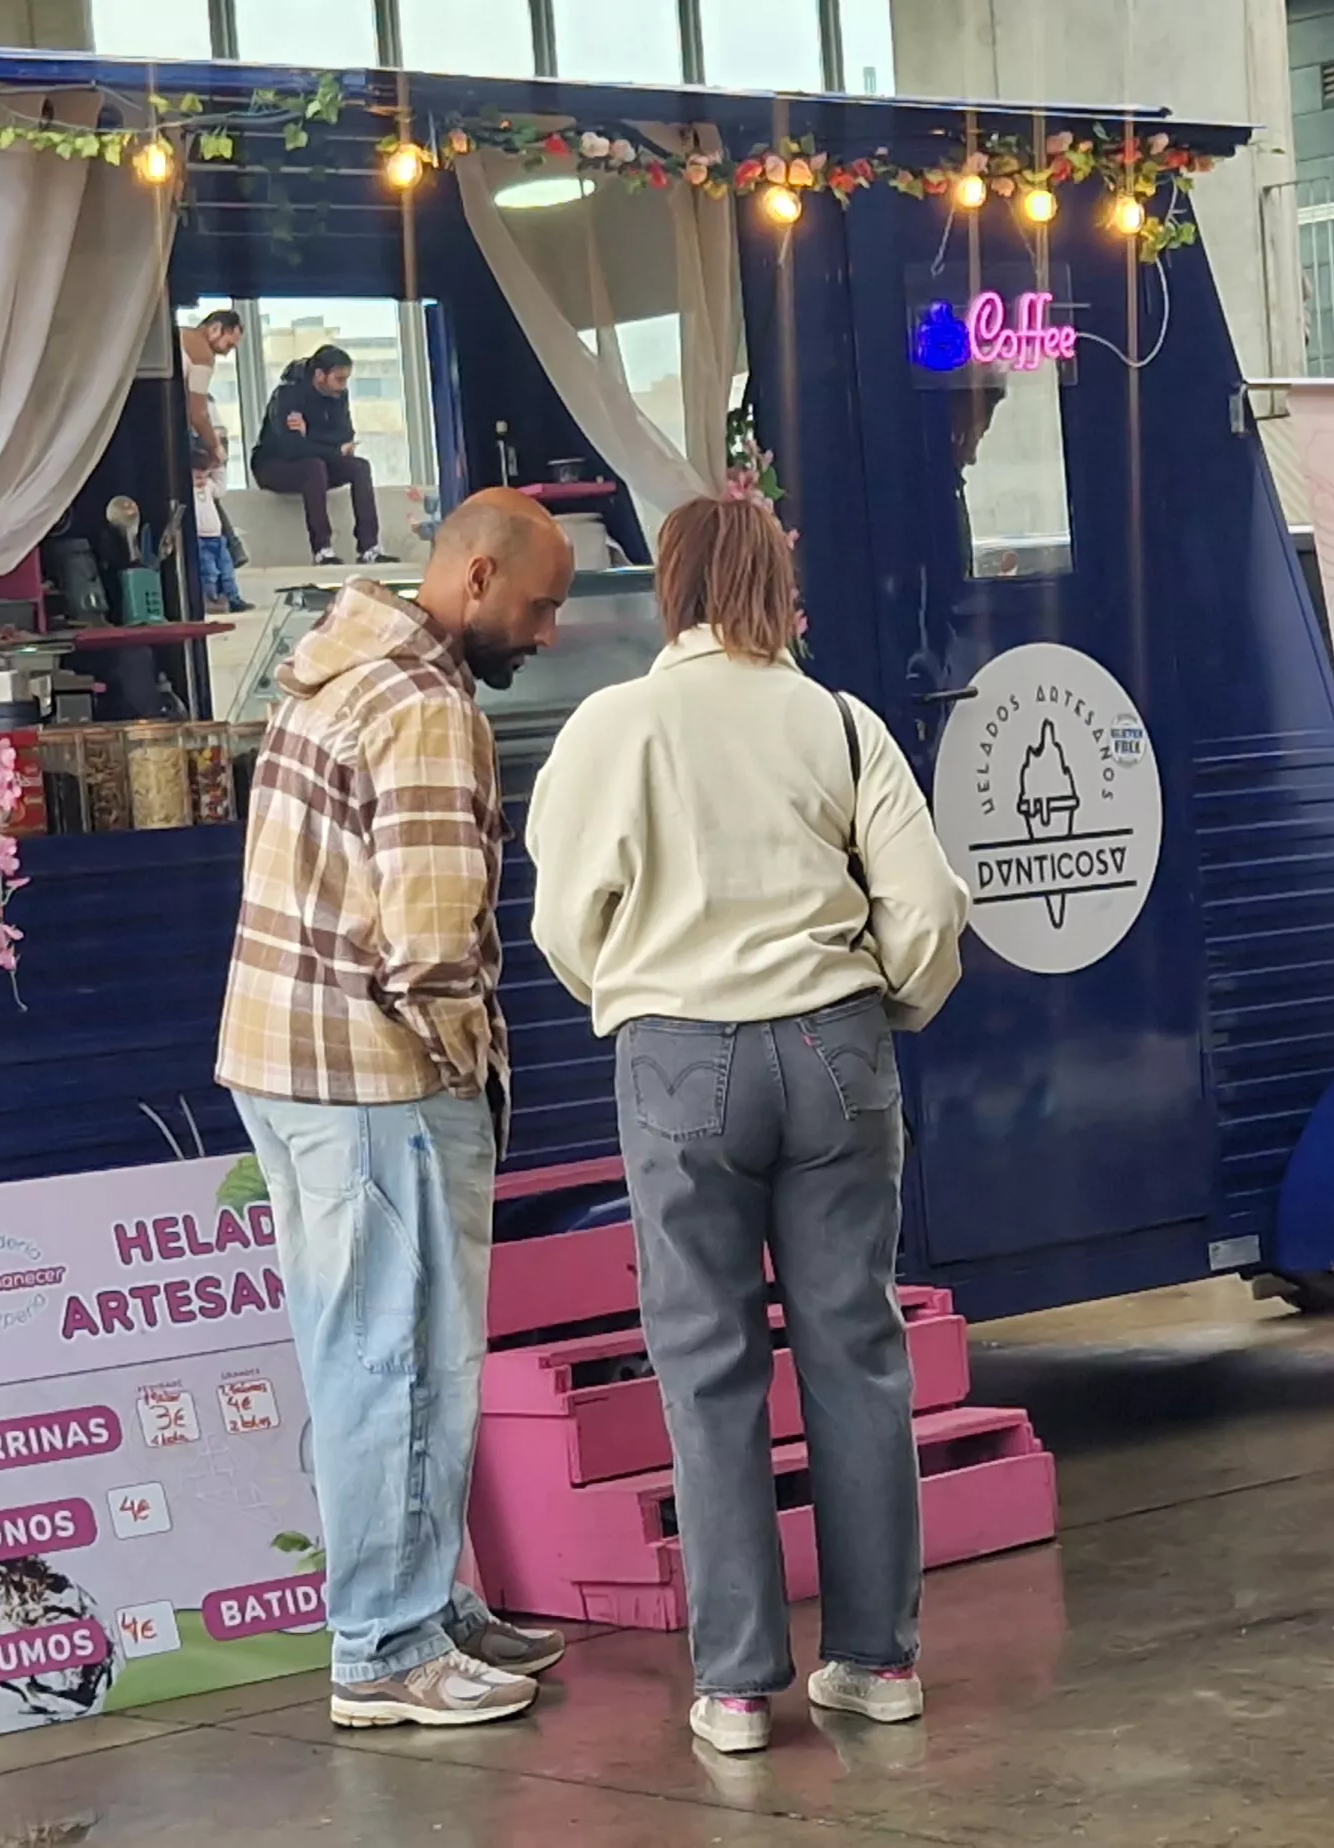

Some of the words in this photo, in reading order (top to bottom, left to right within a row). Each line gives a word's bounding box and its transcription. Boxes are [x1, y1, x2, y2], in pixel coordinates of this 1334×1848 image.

[969, 291, 1076, 369] Coffee
[113, 1204, 276, 1266] HELAD
[148, 1404, 186, 1430] 3€
[227, 1395, 253, 1413] 4€
[119, 1495, 152, 1524] 4€
[120, 1611, 158, 1645] 4€
